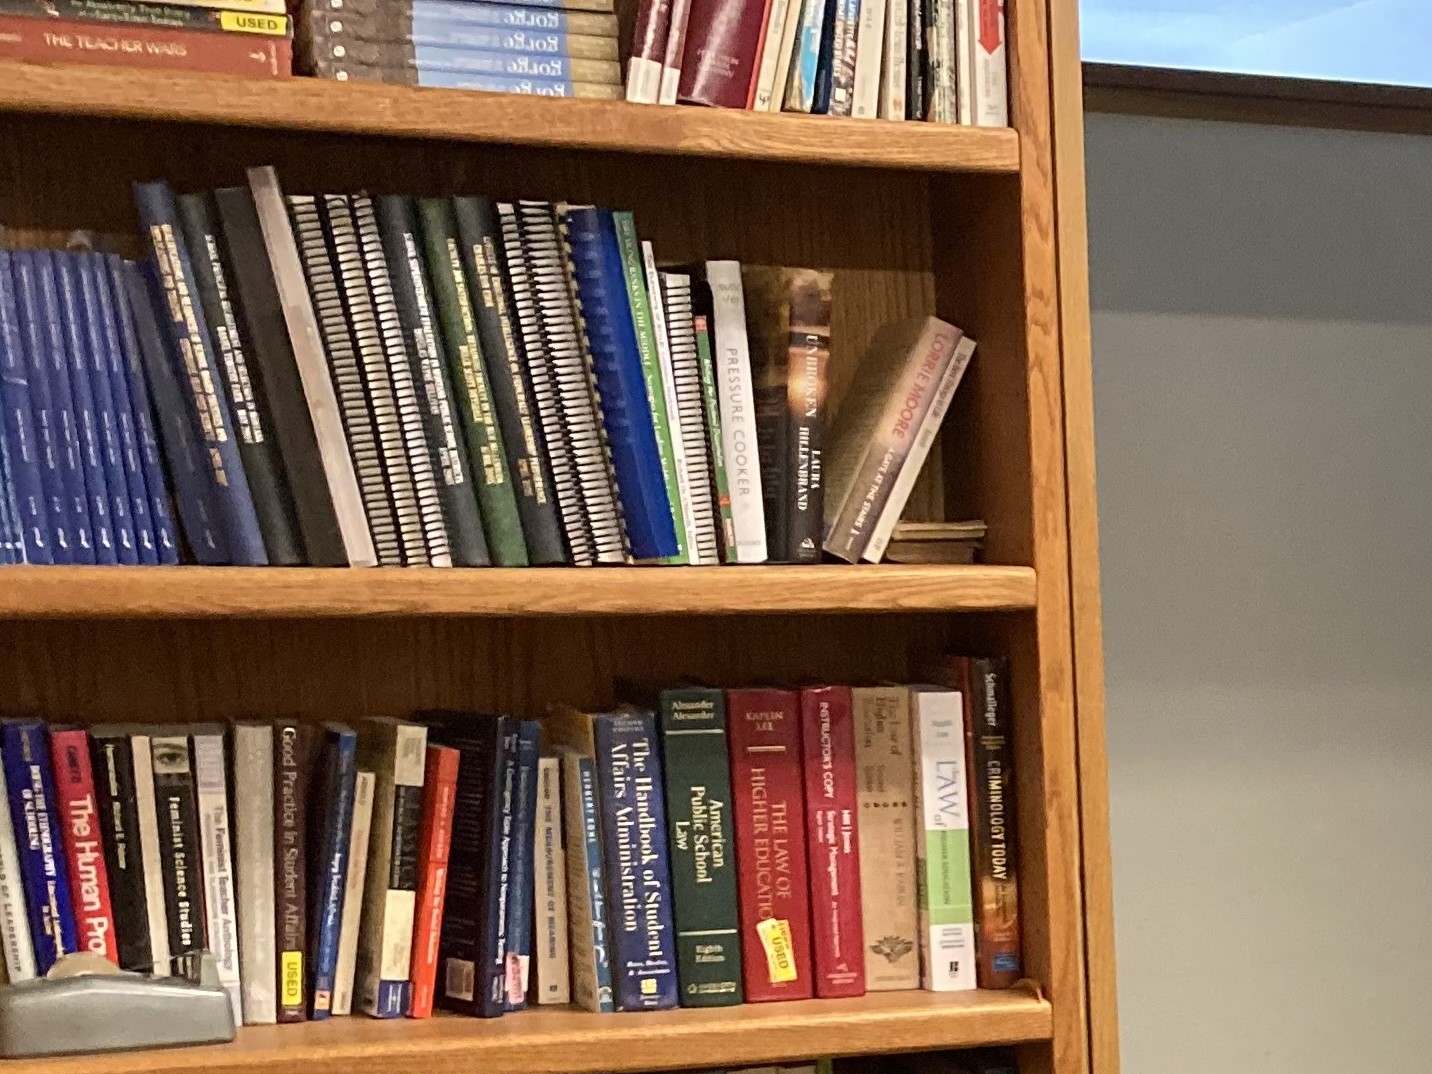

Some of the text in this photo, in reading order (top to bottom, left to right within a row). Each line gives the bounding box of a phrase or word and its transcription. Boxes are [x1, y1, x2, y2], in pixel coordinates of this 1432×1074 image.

[235, 16, 279, 31] USED
[804, 335, 819, 418] UNBROKEN
[916, 333, 946, 382] LORRIE
[726, 348, 750, 497] PRESSURE COOKER
[891, 384, 926, 440] MOORE
[796, 426, 809, 511] HILLENBRAND
[810, 449, 821, 488] LAURA
[878, 453, 892, 473] GATE
[853, 501, 874, 527] STAIRS
[866, 484, 880, 500] THE
[745, 711, 784, 721] KAPLIN
[282, 727, 297, 766] Good
[611, 742, 630, 799] Affairs
[819, 701, 835, 799] INSTRUCTOR'S COPY
[283, 772, 298, 827] Practice
[935, 760, 961, 817] LAW
[987, 760, 1005, 840] CRIMINOLOGY
[69, 795, 92, 837] The
[284, 830, 297, 845] in
[674, 820, 691, 850] Law
[690, 786, 713, 883] Public School
[708, 799, 726, 868] American
[934, 814, 947, 828] of
[215, 827, 227, 873] Feminist
[498, 837, 511, 873] Approach
[615, 806, 639, 932] Administration
[632, 738, 665, 957] The Handbook of Student
[750, 768, 773, 921] HIGHER EDUCATIO
[770, 802, 792, 900] THE LAW OF
[991, 842, 1007, 879] TODAY
[75, 842, 102, 911] Human
[169, 797, 192, 946] Feminist Science Studies
[219, 876, 231, 916] Teacher
[284, 848, 298, 898] Student
[2, 903, 21, 973] LEADERSHIP
[222, 918, 234, 972] Anthology
[771, 936, 790, 970] USED
[286, 961, 298, 997] USED
